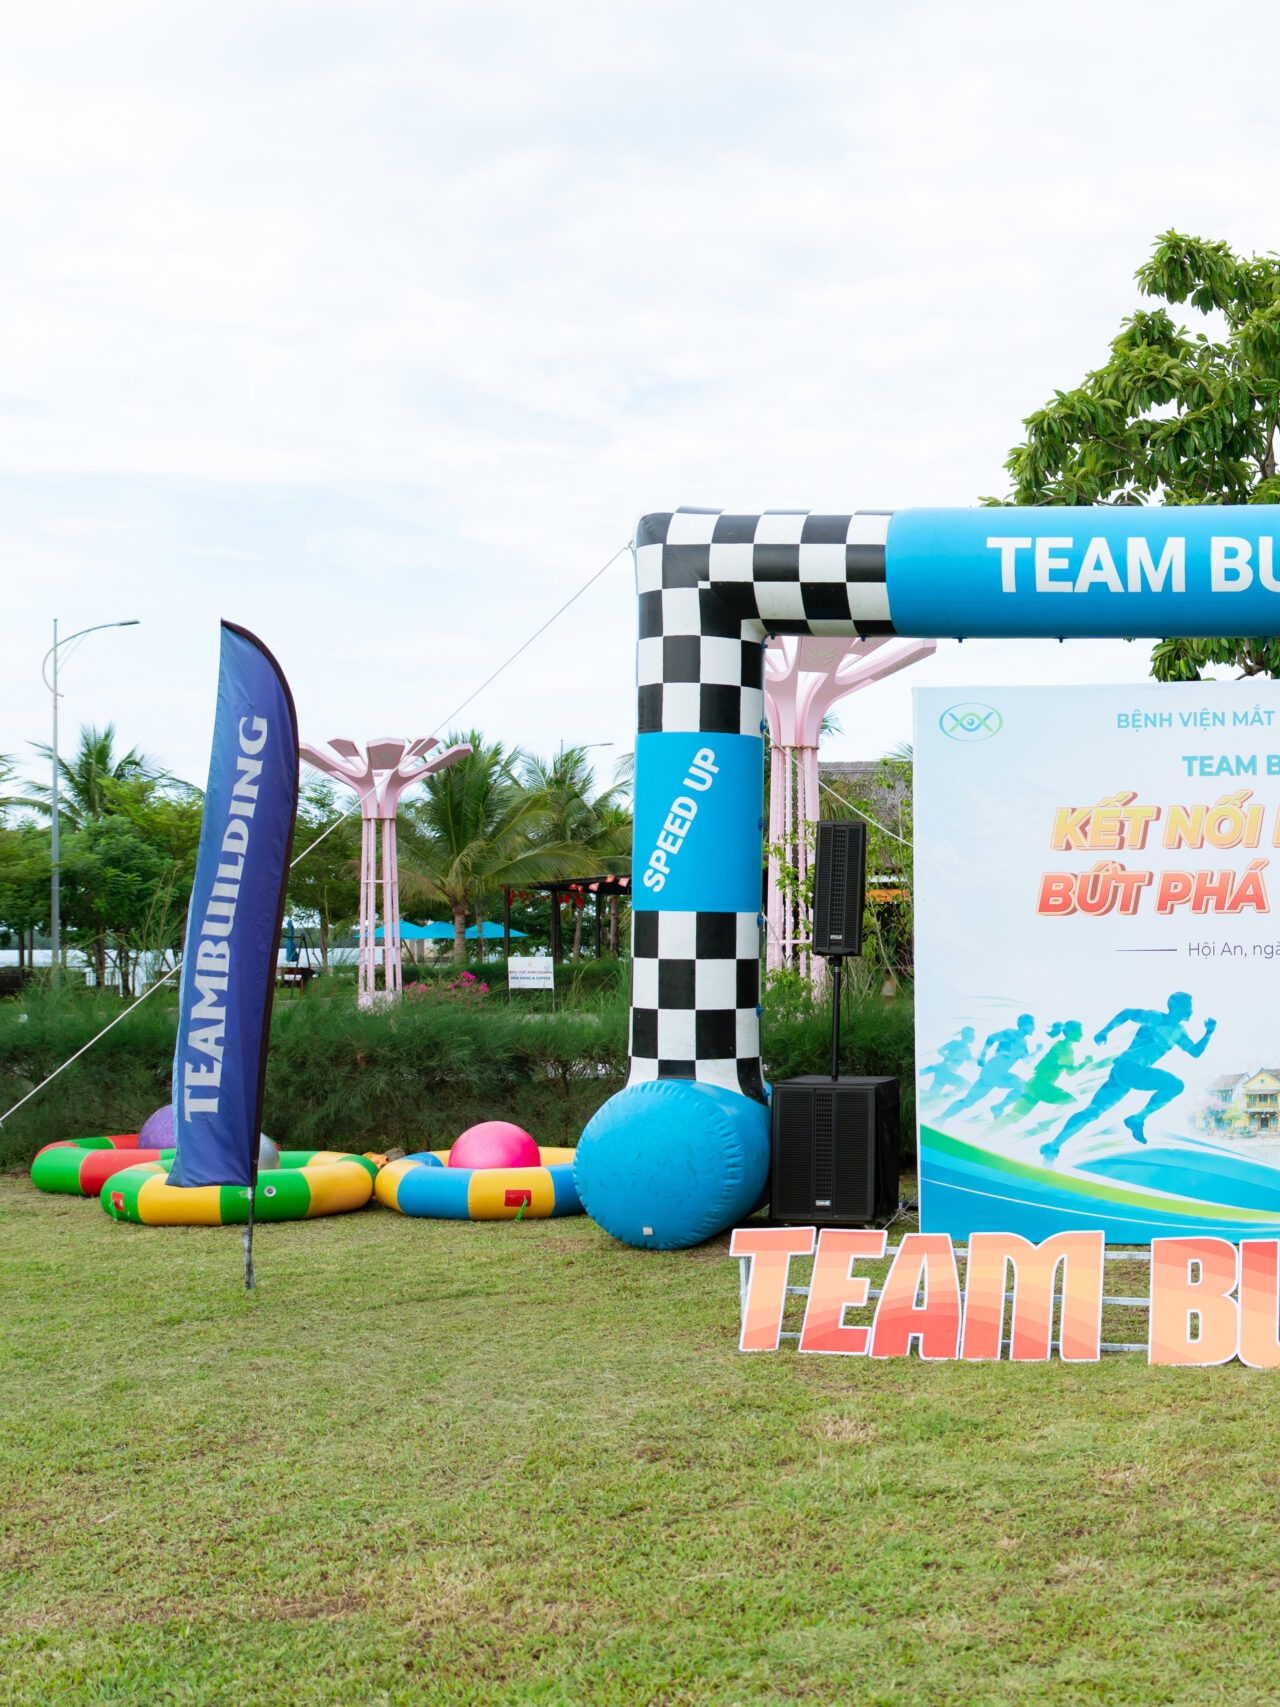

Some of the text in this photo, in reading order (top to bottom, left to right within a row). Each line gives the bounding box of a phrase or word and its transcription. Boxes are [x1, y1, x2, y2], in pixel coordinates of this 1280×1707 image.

[986, 536, 1186, 593] TEAM
[1116, 709, 1173, 732] BỆNH
[1178, 707, 1226, 731] VIỆN
[1232, 704, 1276, 726] MẮT
[1181, 755, 1257, 777] TEAM
[643, 747, 720, 893] SPEED UP
[1050, 791, 1161, 851] KẾT
[1162, 789, 1265, 849] NỐI
[1034, 860, 1153, 916] BỨT
[1154, 858, 1270, 915] PHÁ
[184, 715, 268, 1124] TEAMBUILDING
[1188, 942, 1216, 960] Hội
[1220, 942, 1248, 958] An,
[729, 1226, 1105, 1362] TEAM
